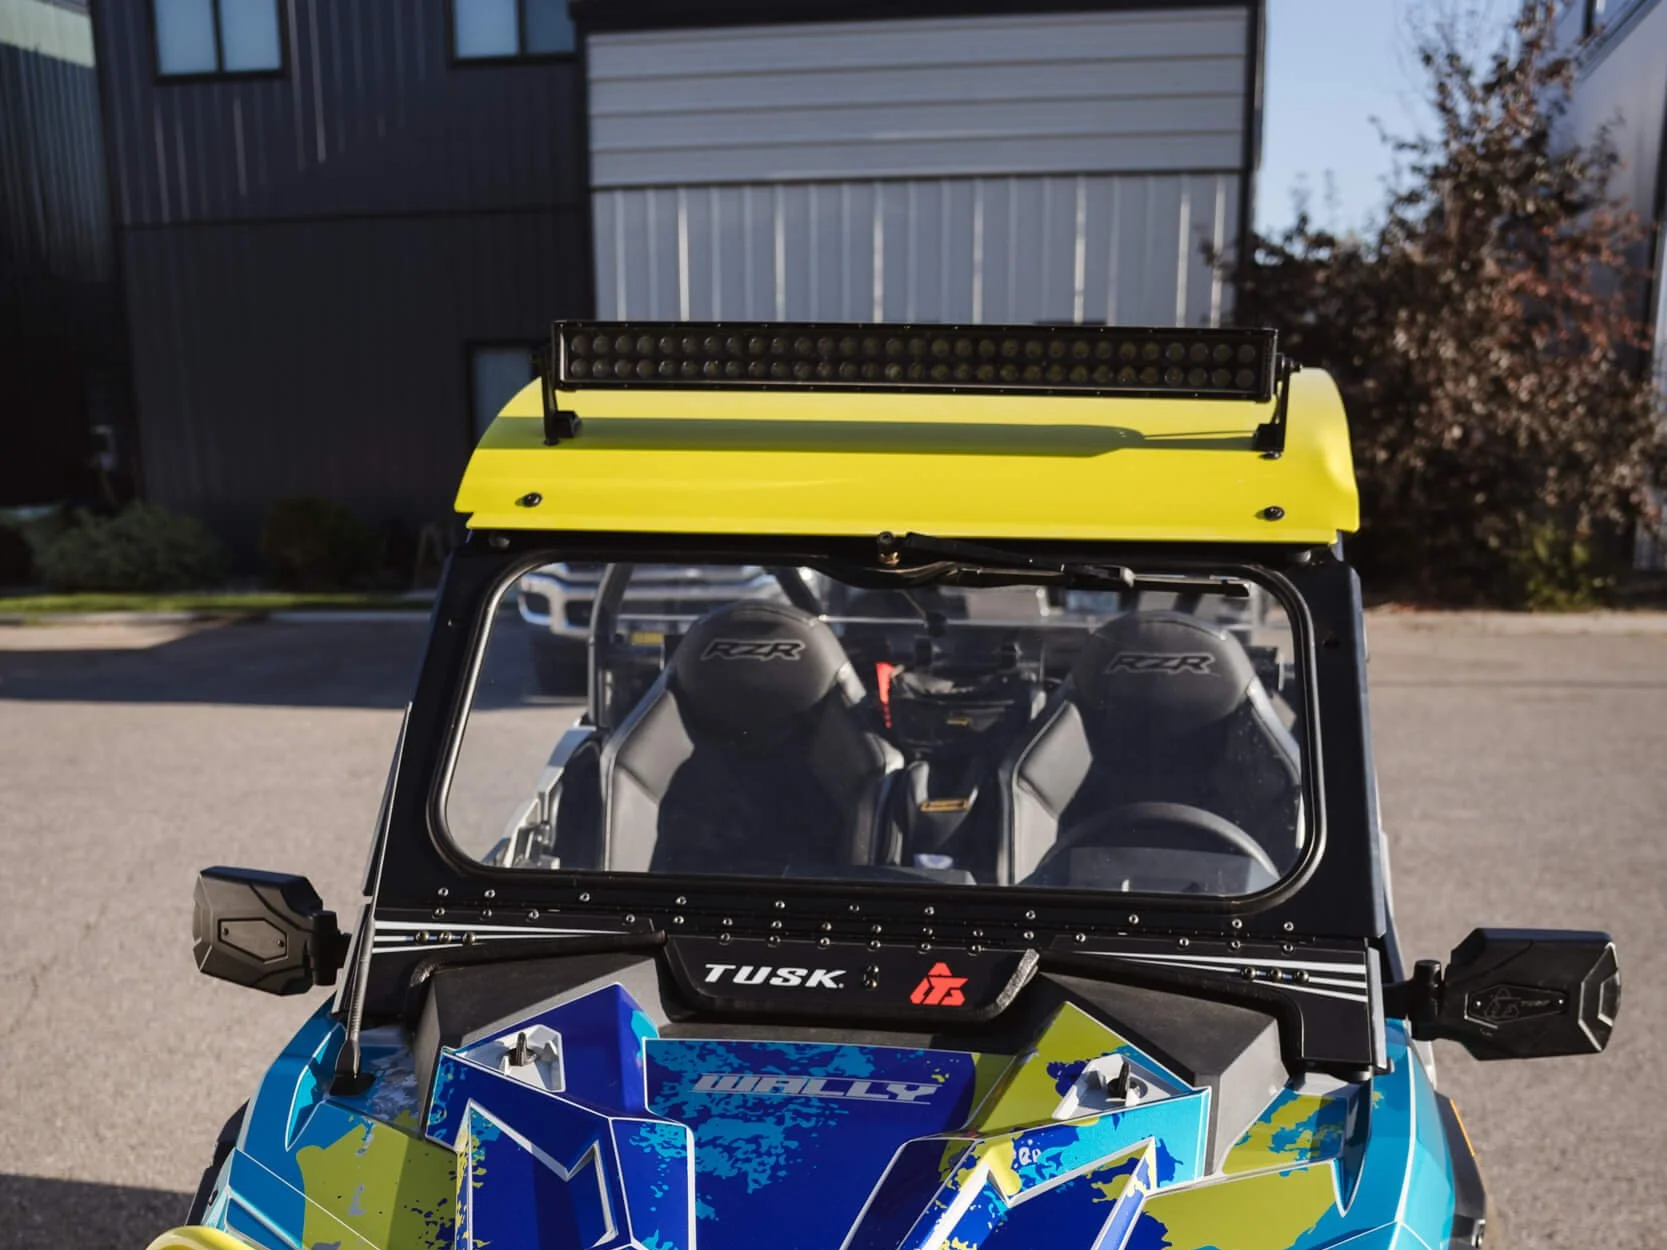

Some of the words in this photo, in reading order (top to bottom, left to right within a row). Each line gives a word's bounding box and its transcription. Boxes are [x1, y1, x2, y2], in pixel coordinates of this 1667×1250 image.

[699, 636, 806, 662] RZR
[1103, 650, 1216, 674] RZR
[704, 963, 846, 989] TUSK
[691, 1074, 940, 1102] WALLY
